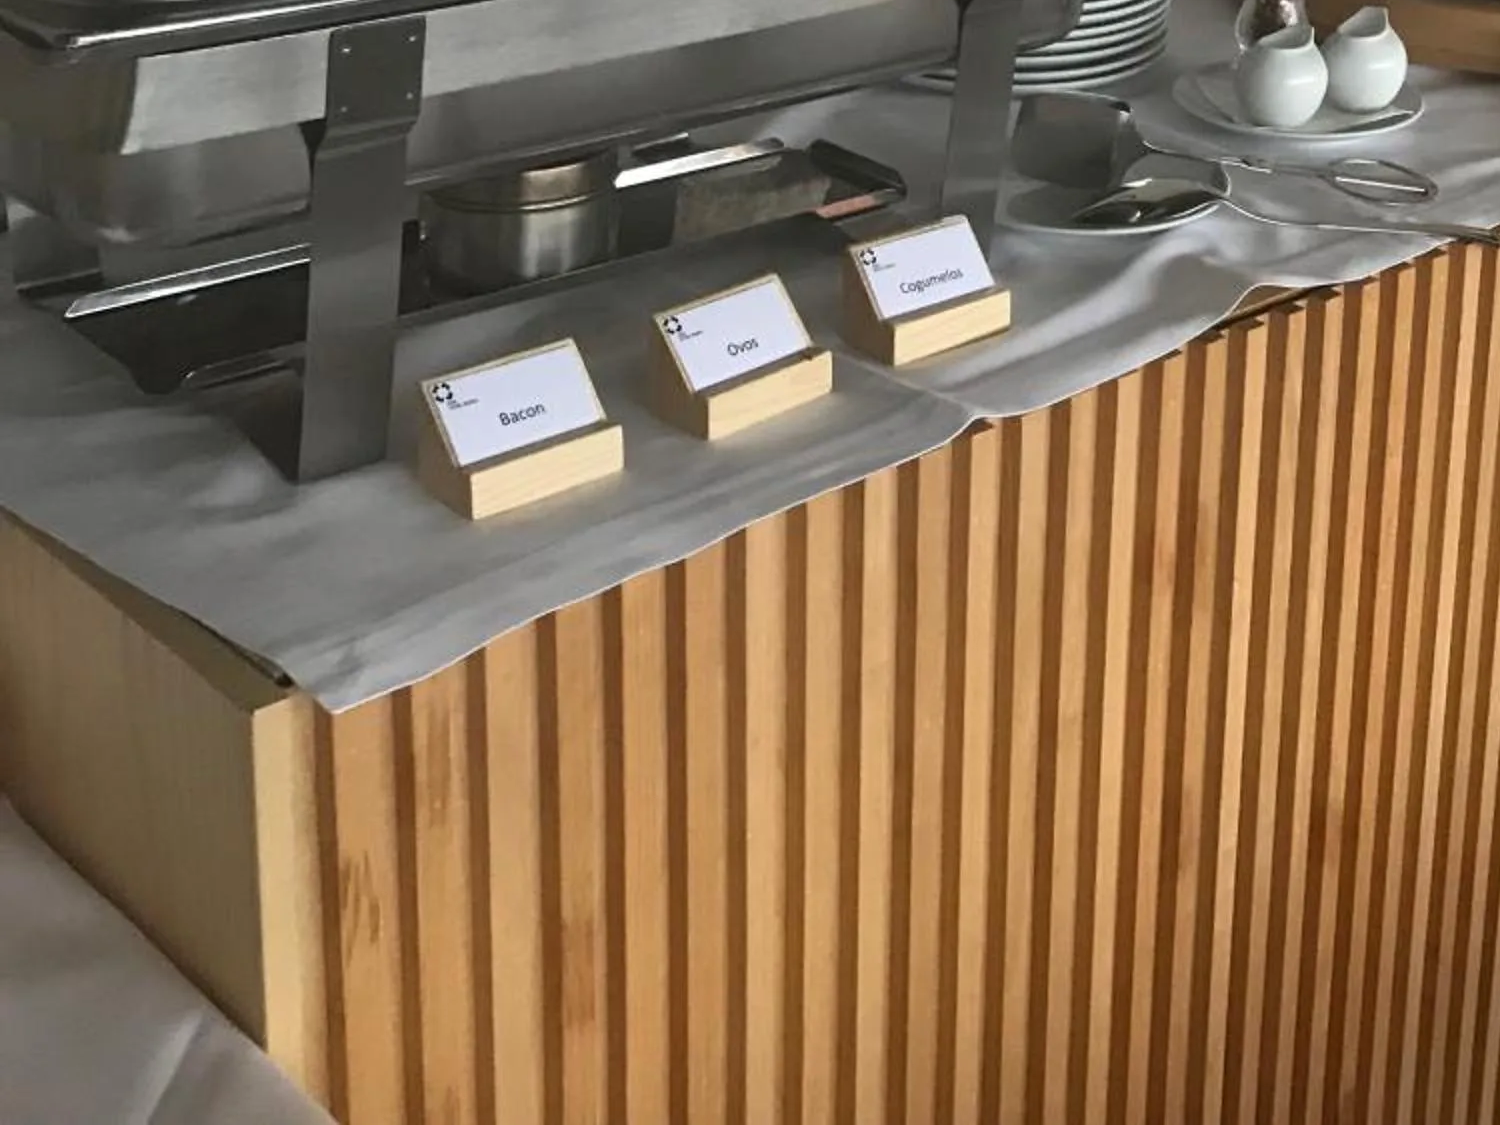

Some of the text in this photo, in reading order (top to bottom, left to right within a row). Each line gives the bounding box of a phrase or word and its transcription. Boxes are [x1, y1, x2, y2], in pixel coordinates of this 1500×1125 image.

[900, 268, 964, 295] Cogumelos
[727, 338, 759, 356] Ovos
[499, 403, 546, 426] Bacon
